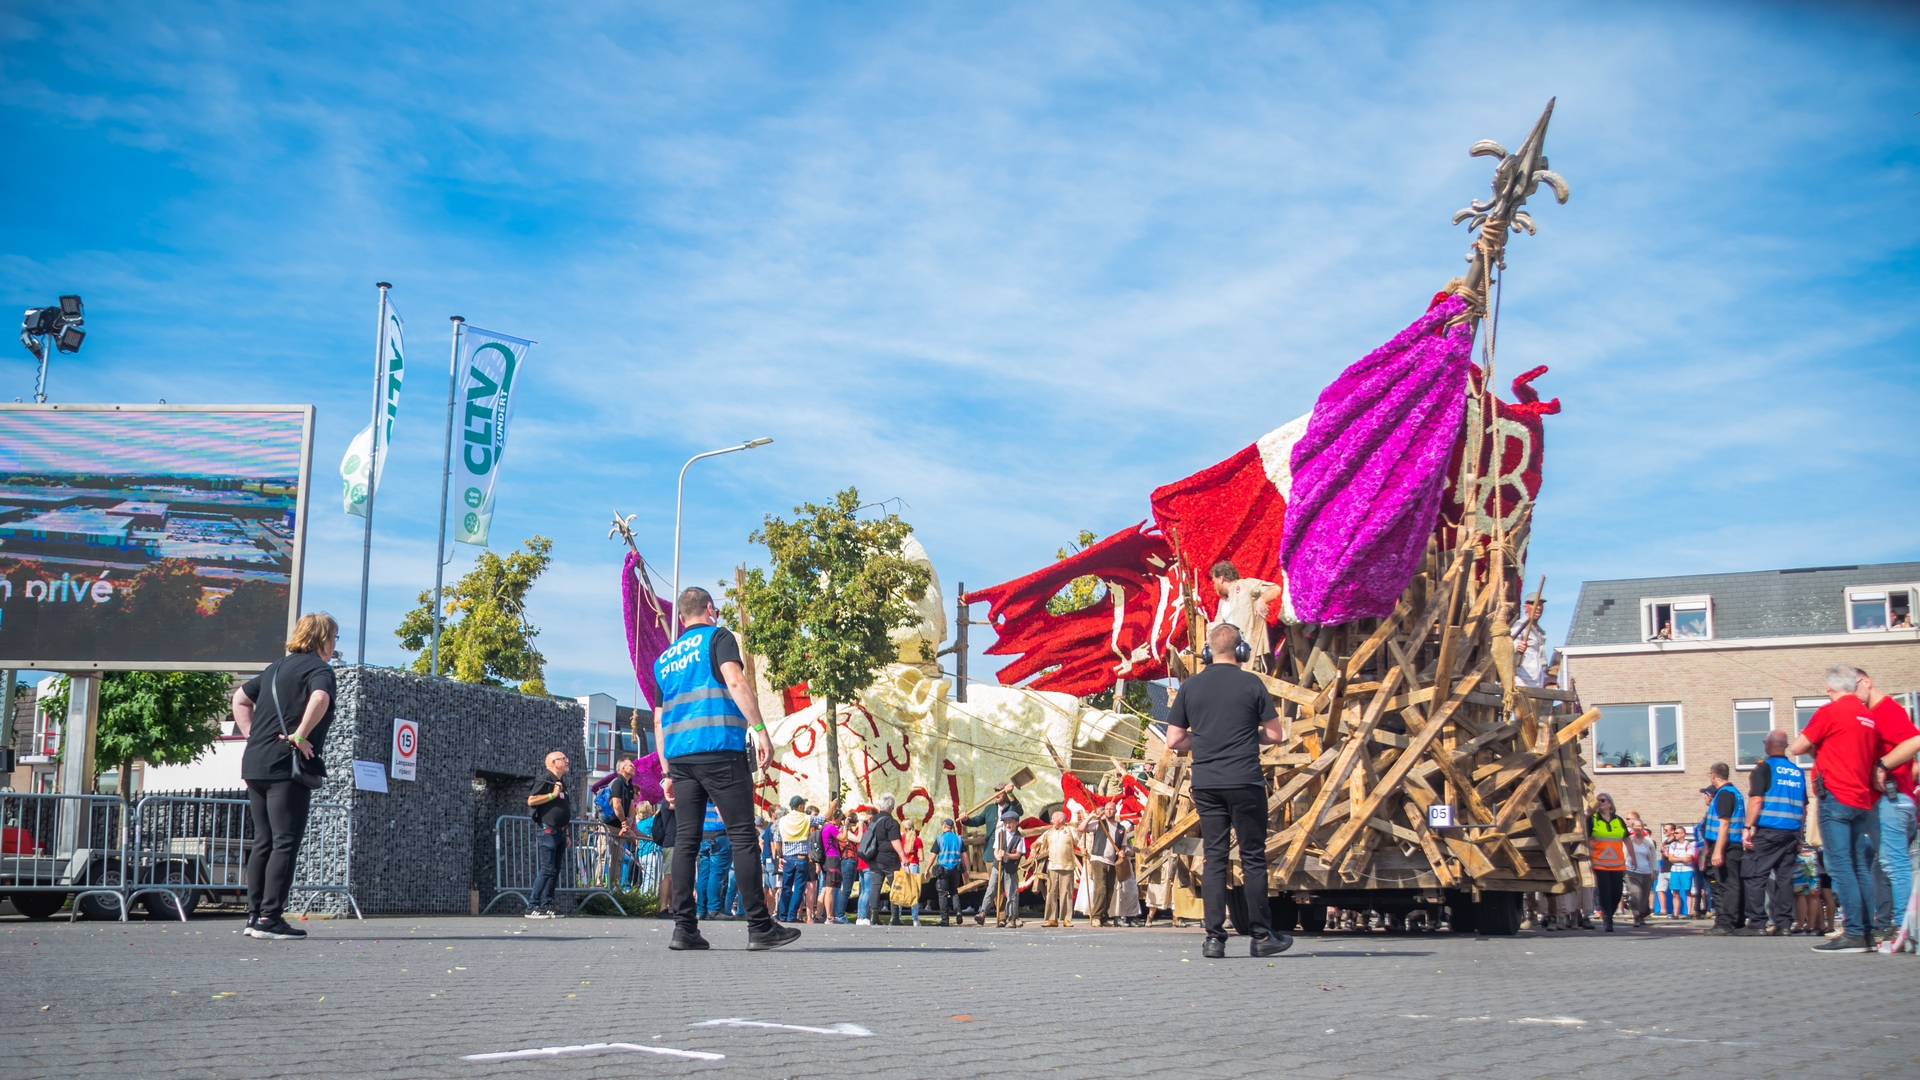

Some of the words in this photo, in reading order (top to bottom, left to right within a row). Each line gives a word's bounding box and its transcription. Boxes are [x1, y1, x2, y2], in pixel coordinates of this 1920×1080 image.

[464, 365, 498, 475] CLTV
[496, 388, 508, 448] ZUNDERT
[25, 570, 113, 603] privé
[659, 633, 703, 665] corso
[660, 648, 701, 680] zundrt
[401, 733, 412, 748] 15
[1776, 766, 1801, 777] corso
[1431, 808, 1447, 819] 05
